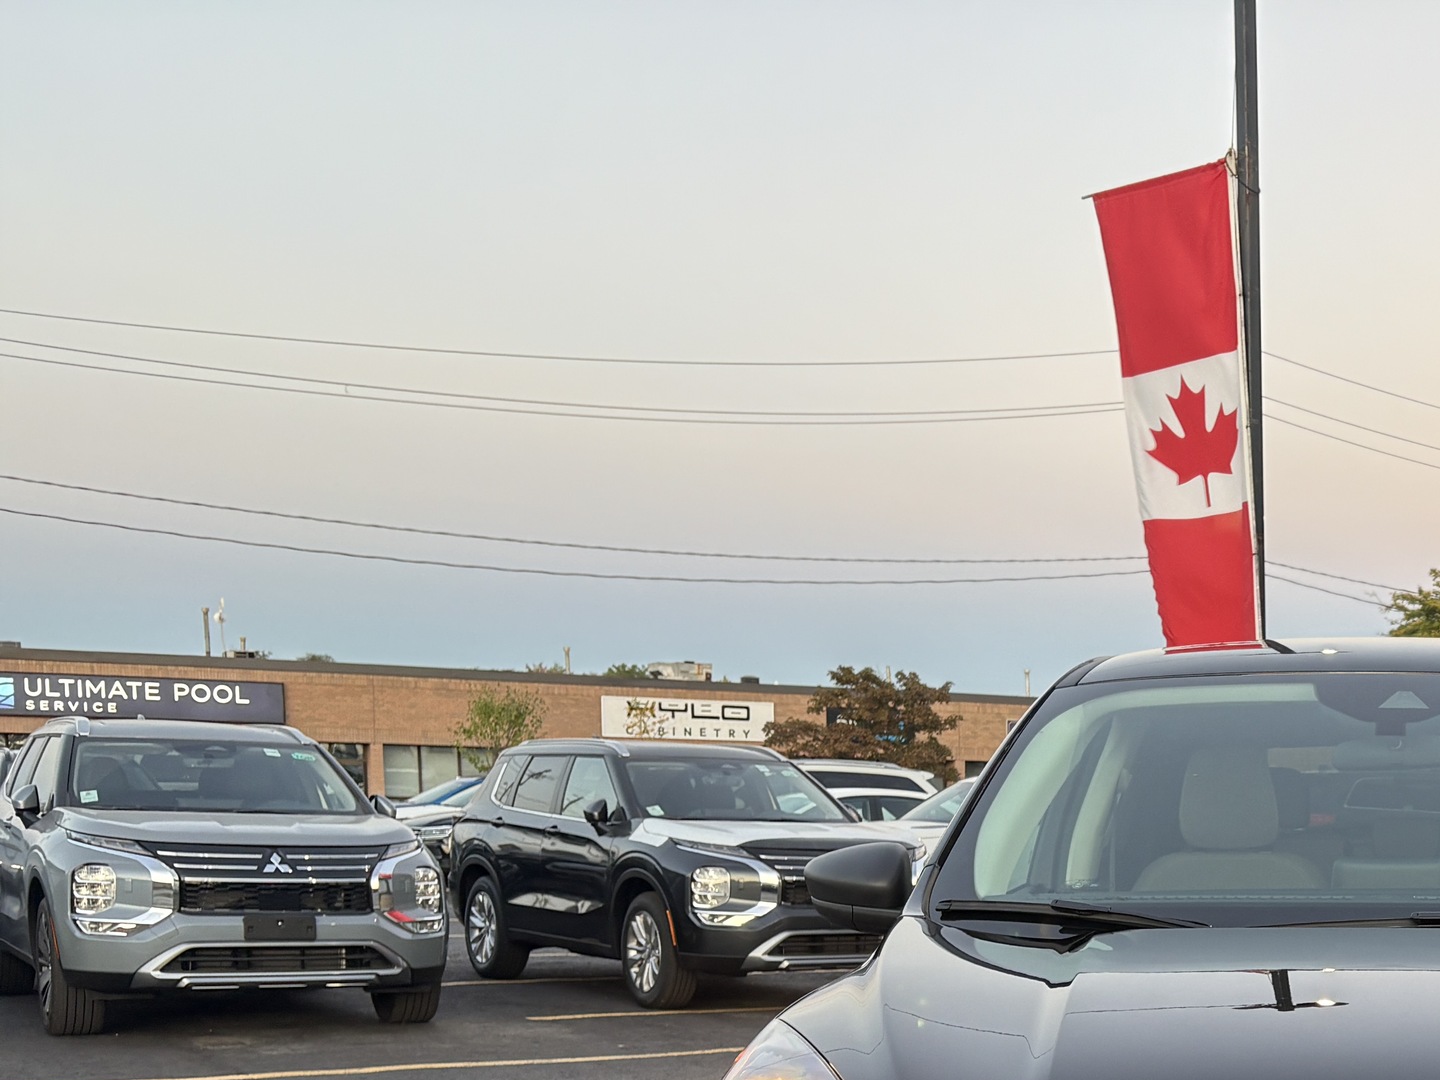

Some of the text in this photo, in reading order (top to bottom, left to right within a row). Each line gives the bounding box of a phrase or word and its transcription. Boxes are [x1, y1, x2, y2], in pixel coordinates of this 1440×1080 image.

[23, 677, 250, 705] ULTIMATE POOL
[25, 699, 118, 713] SERVICE
